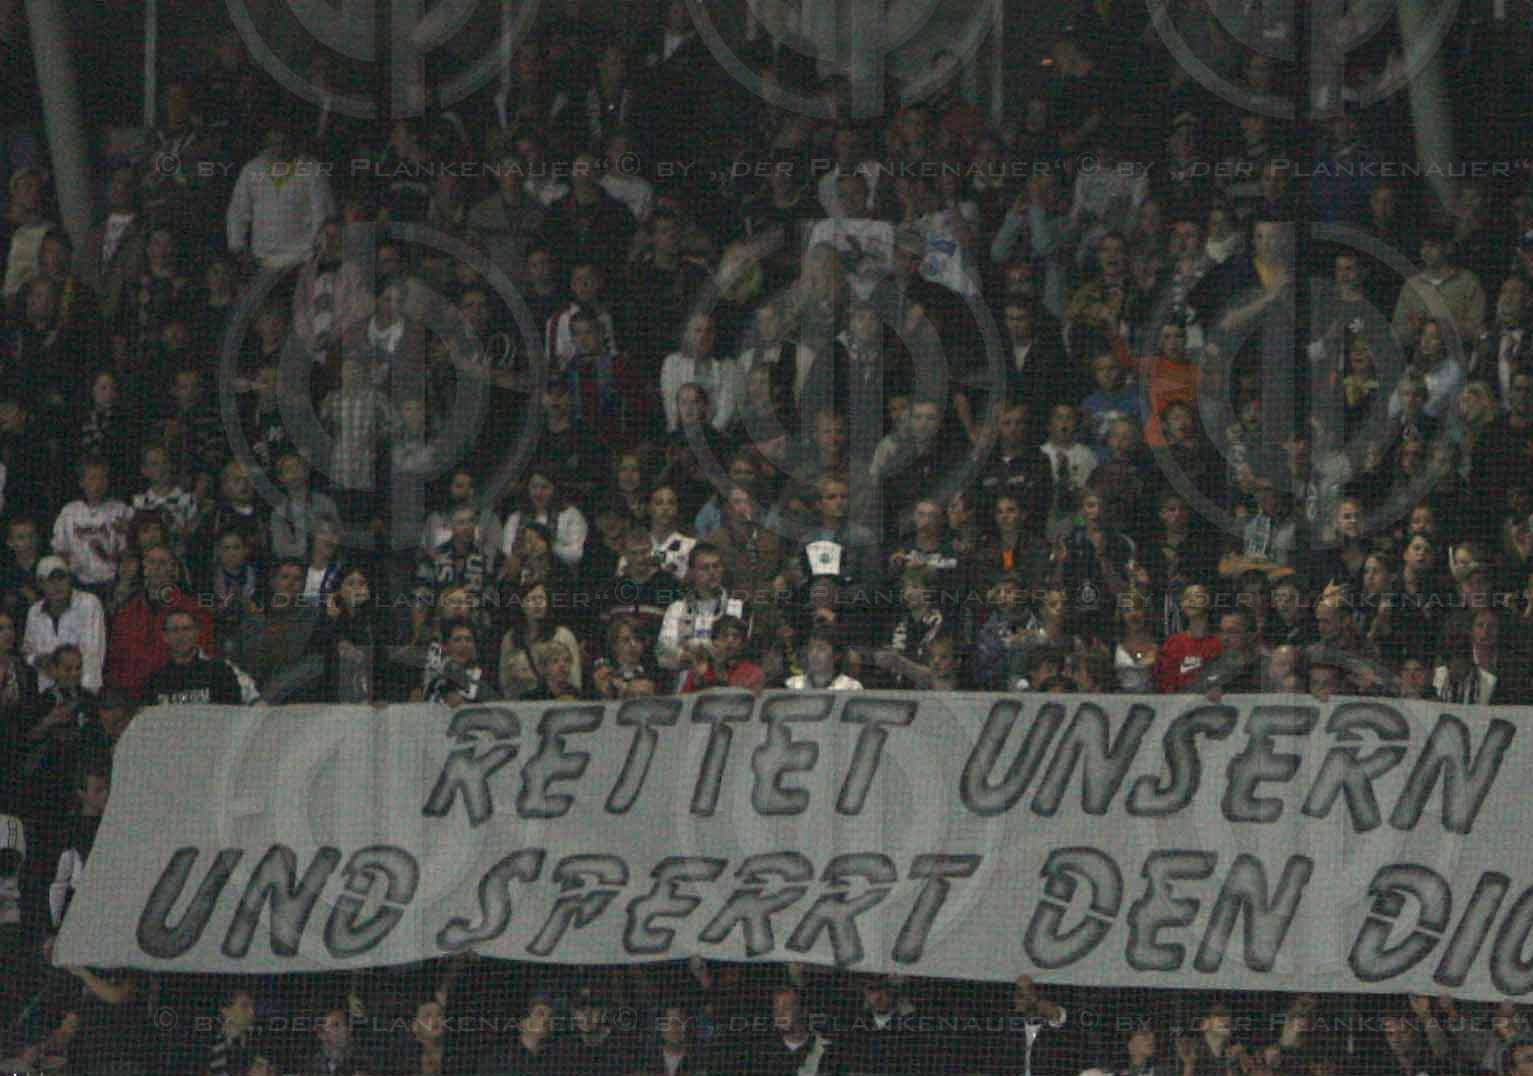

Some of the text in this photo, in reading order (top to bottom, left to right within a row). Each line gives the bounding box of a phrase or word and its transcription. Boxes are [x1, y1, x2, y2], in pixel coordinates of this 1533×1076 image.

[422, 690, 918, 827] RETTET
[959, 700, 1516, 834] UNSERN
[136, 845, 419, 959] UND
[436, 848, 983, 967] SPERRT
[1023, 846, 1314, 973] DEN
